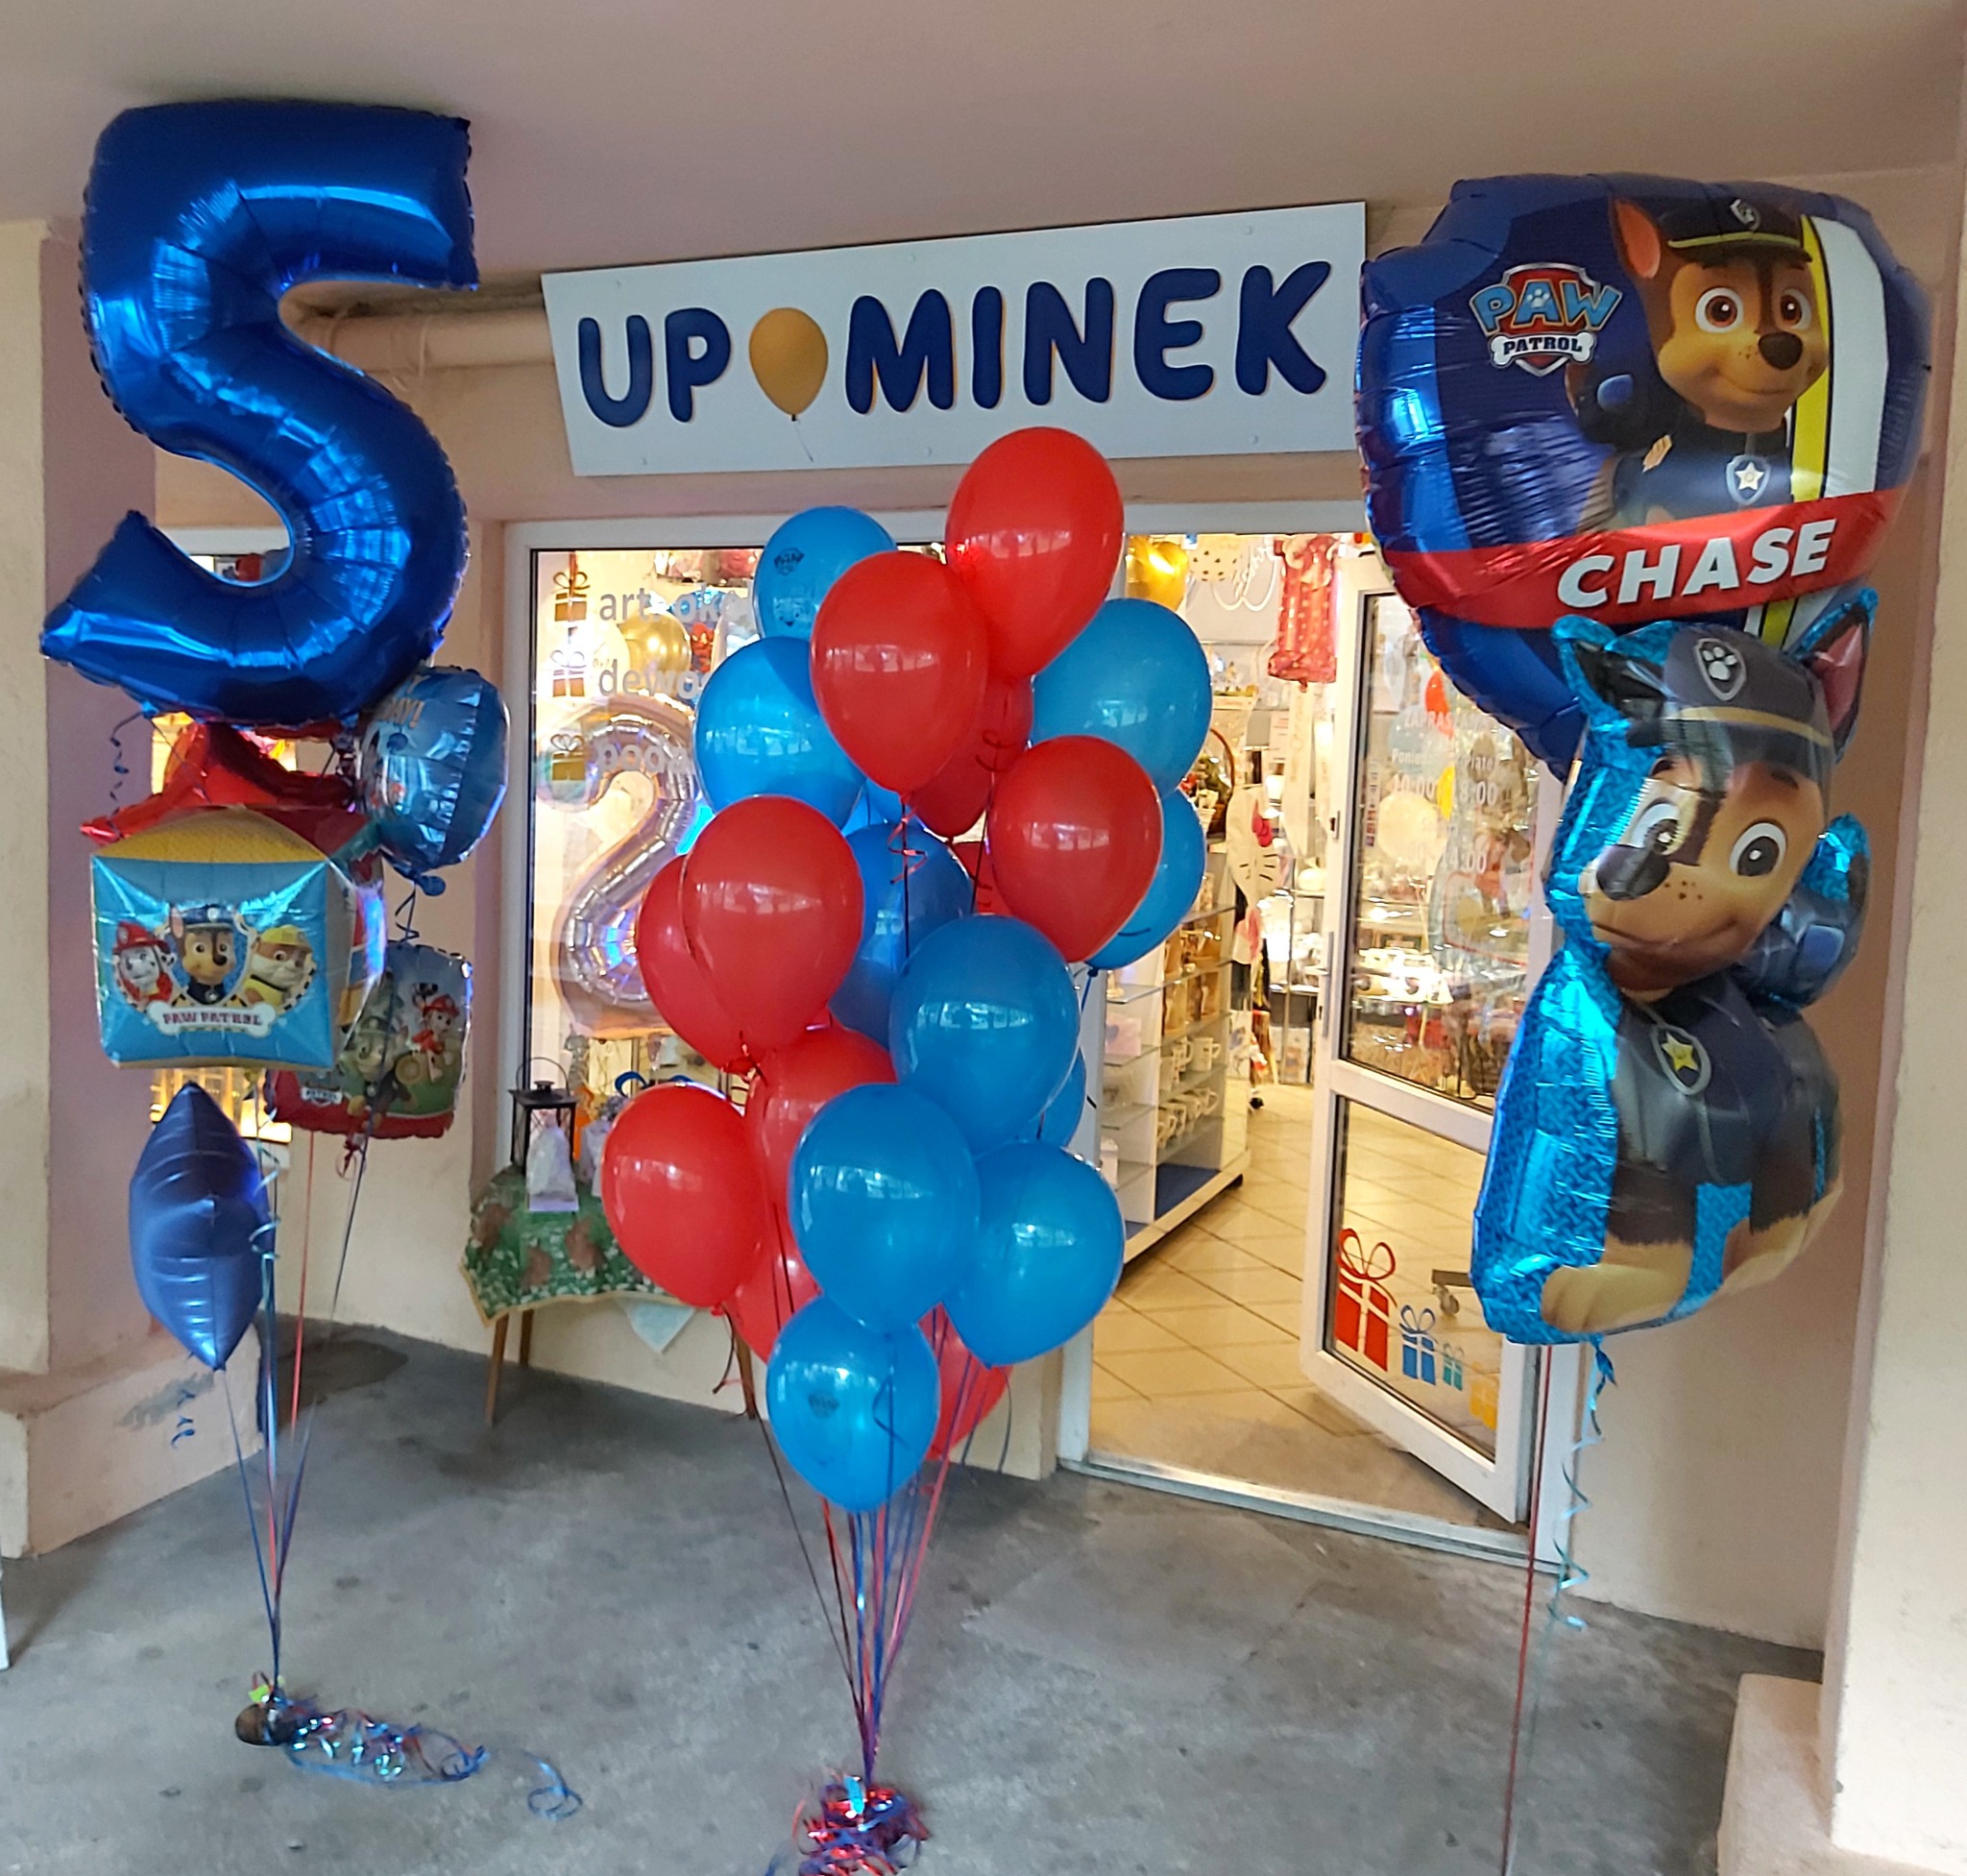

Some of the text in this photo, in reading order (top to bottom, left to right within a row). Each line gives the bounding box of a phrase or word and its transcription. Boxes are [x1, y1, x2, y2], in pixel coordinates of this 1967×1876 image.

[1469, 279, 1623, 336] PAW
[1503, 336, 1583, 355] PATROL
[40, 98, 479, 728] 5
[1557, 520, 1836, 609] CHASE
[1452, 778, 1498, 806] 8:00
[162, 1011, 263, 1026] PAW PATROL
